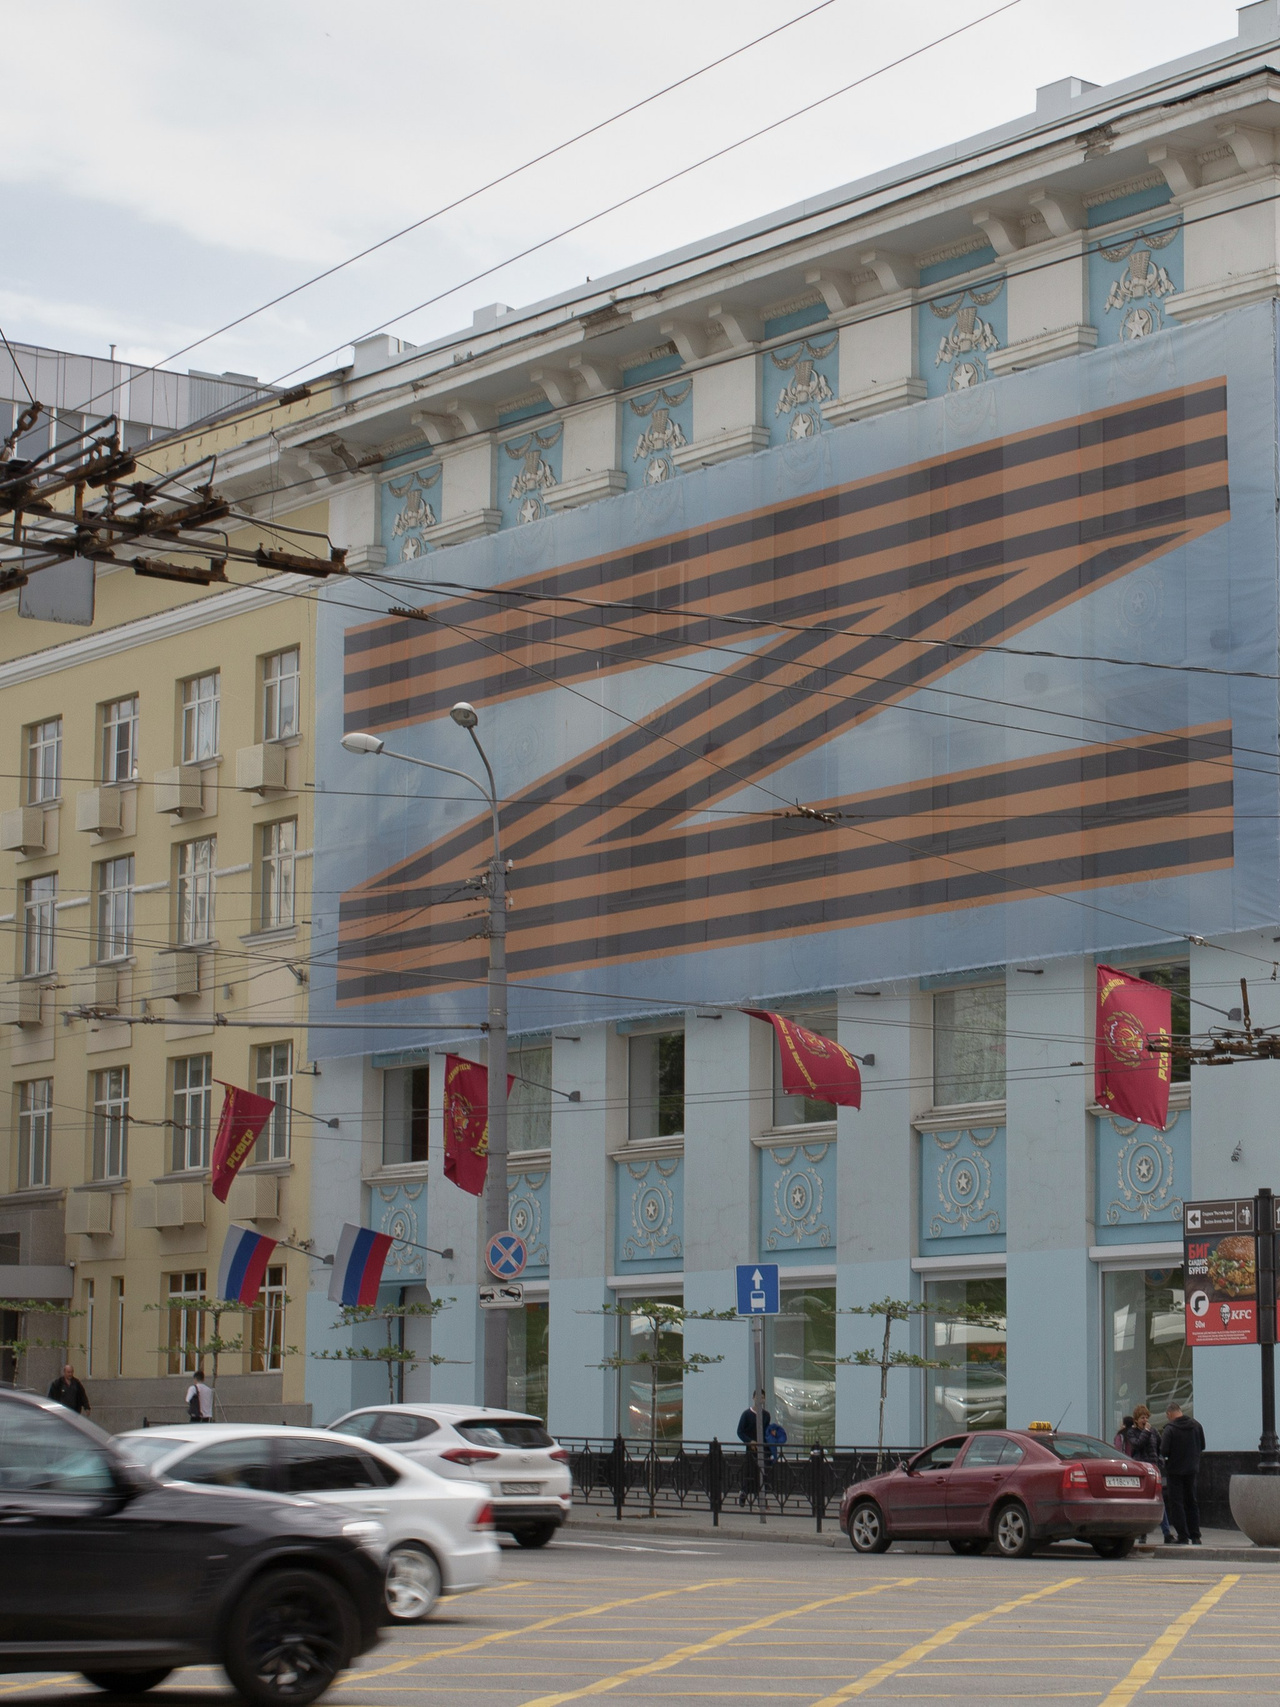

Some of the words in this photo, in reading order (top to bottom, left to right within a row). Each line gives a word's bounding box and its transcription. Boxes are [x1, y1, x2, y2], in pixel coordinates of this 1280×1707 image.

[226, 1128, 254, 1169] РСФСР
[1188, 1242, 1210, 1259] БИГ
[1188, 1258, 1208, 1266] САНДЕРС
[1188, 1266, 1209, 1275] БУРГЕР
[1231, 1309, 1252, 1320] KFC
